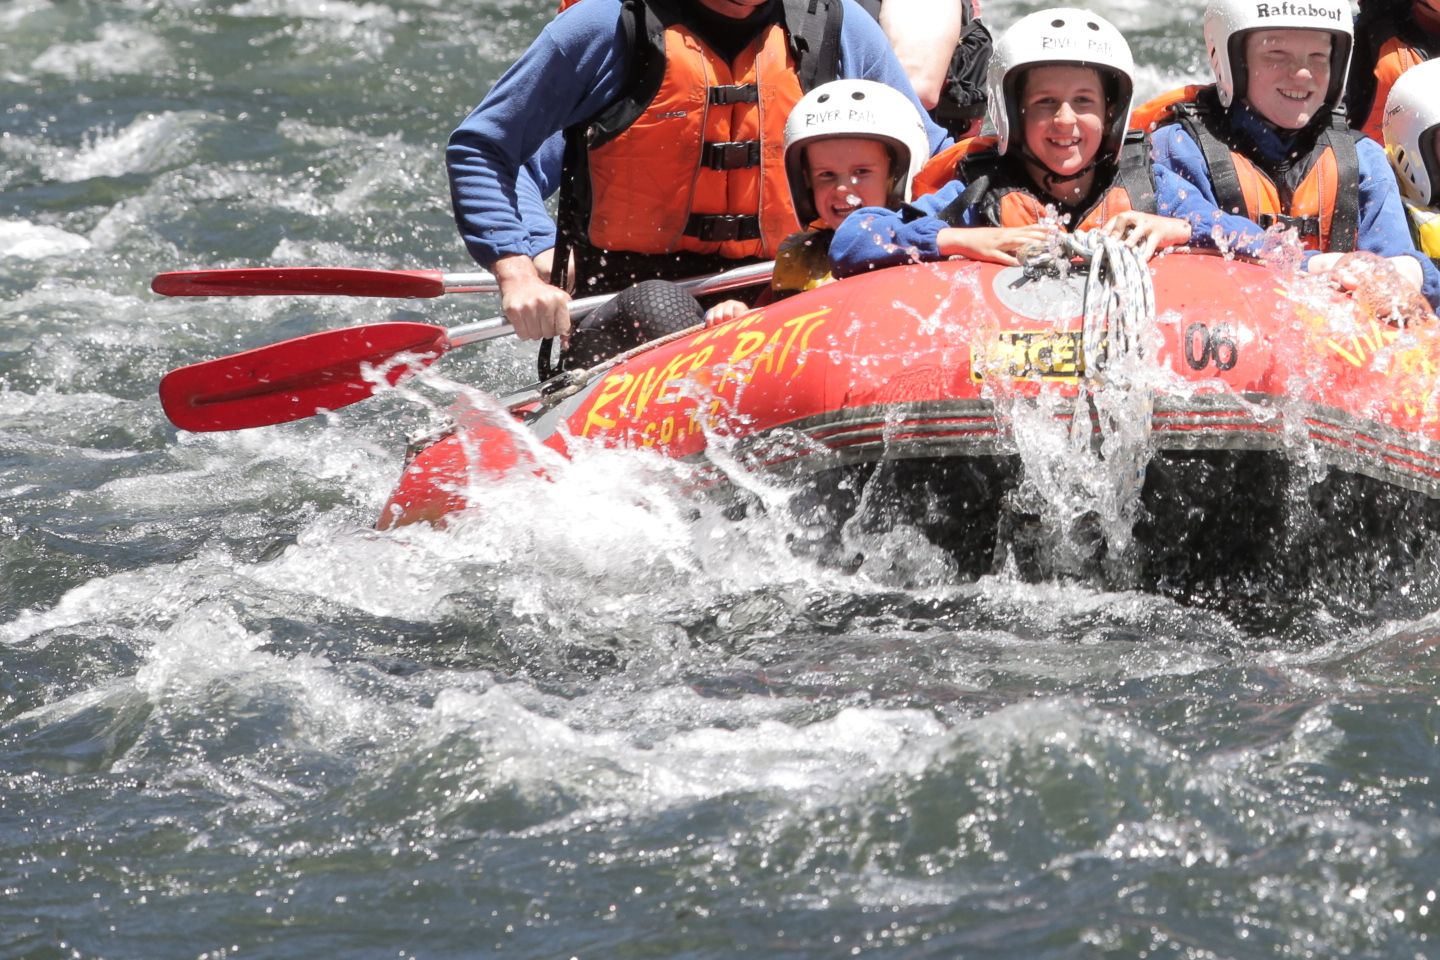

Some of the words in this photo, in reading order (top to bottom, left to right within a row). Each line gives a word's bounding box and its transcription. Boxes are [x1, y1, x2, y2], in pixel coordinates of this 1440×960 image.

[1256, 1, 1342, 21] Raftabout
[1040, 36, 1080, 50] RIVE
[804, 108, 842, 128] RIVER
[1184, 322, 1238, 371] 06
[580, 343, 715, 438] RIVER
[717, 307, 833, 394] RATS
